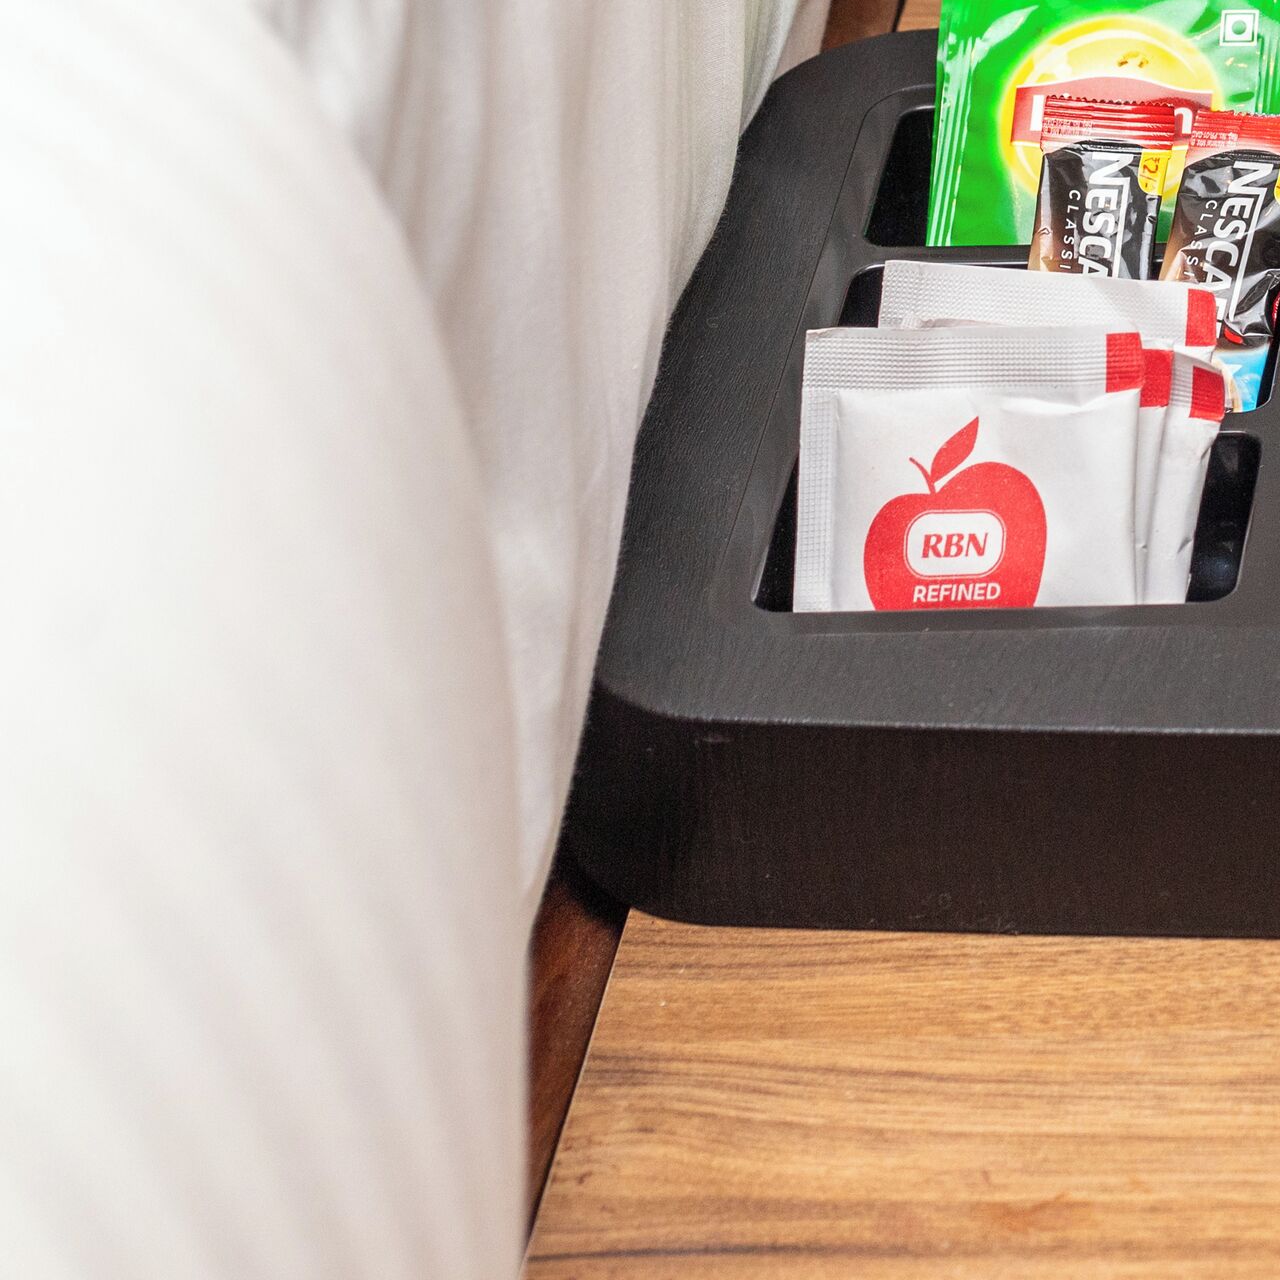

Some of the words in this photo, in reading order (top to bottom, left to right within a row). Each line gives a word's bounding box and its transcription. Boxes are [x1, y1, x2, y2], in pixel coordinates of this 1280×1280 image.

[1060, 190, 1081, 269] CLASSI
[921, 532, 988, 558] RBN
[913, 582, 1001, 603] REFINED
